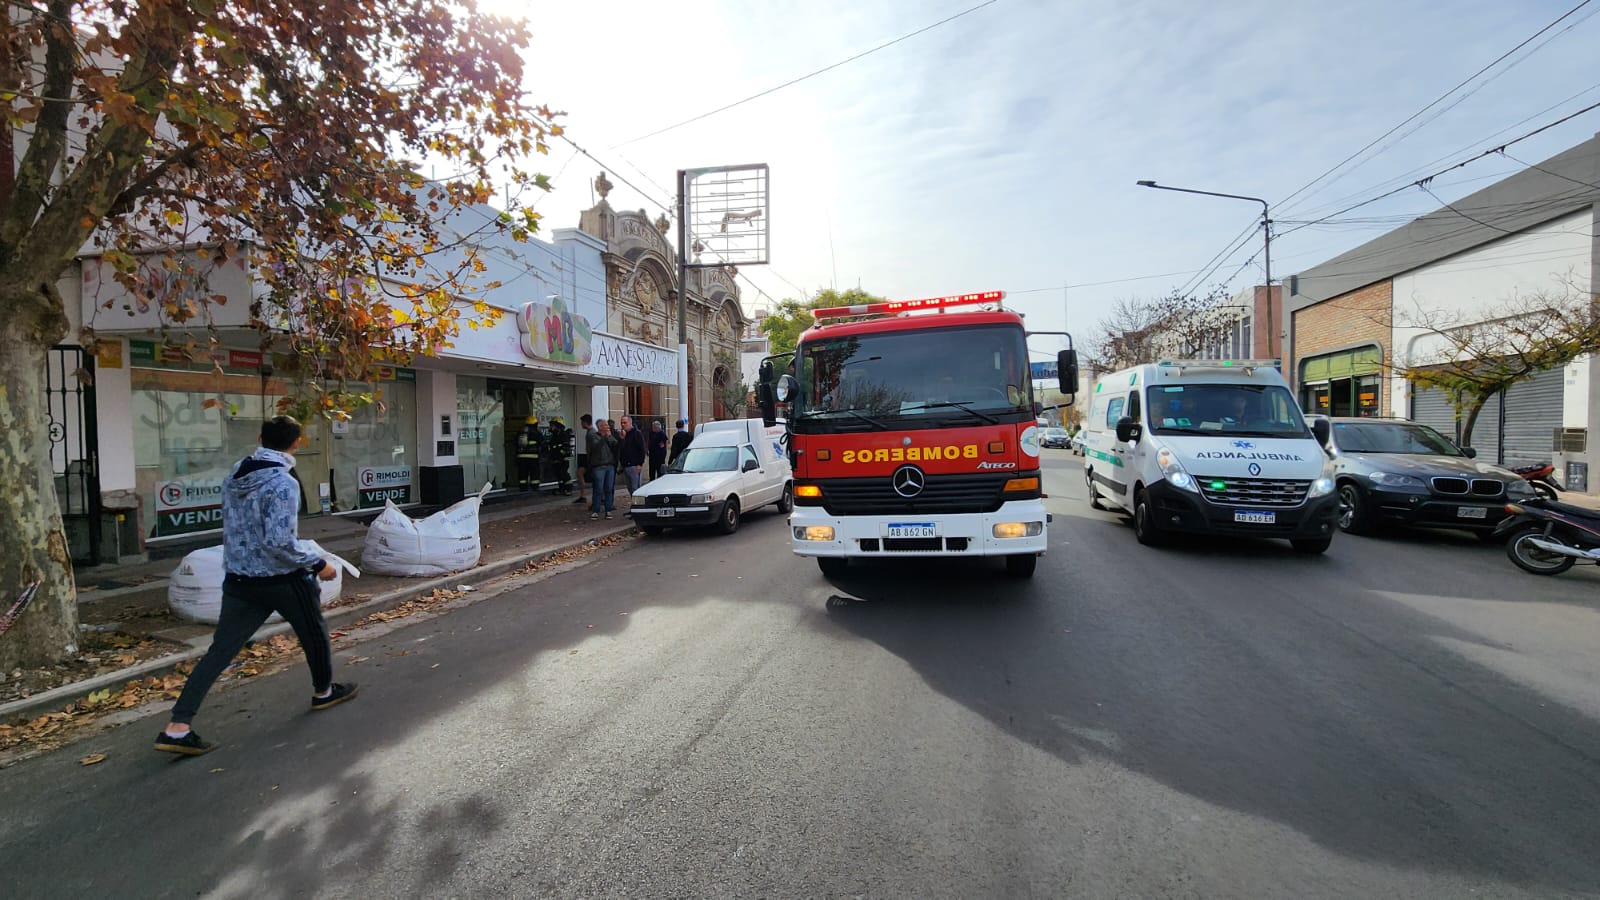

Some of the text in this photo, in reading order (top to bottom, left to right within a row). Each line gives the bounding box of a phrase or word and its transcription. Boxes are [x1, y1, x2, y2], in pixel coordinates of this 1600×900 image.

[376, 470, 410, 480] RIMOLDI
[366, 488, 406, 502] VENDE
[168, 508, 223, 526] VEND
[890, 528, 934, 536] AB 862 GN
